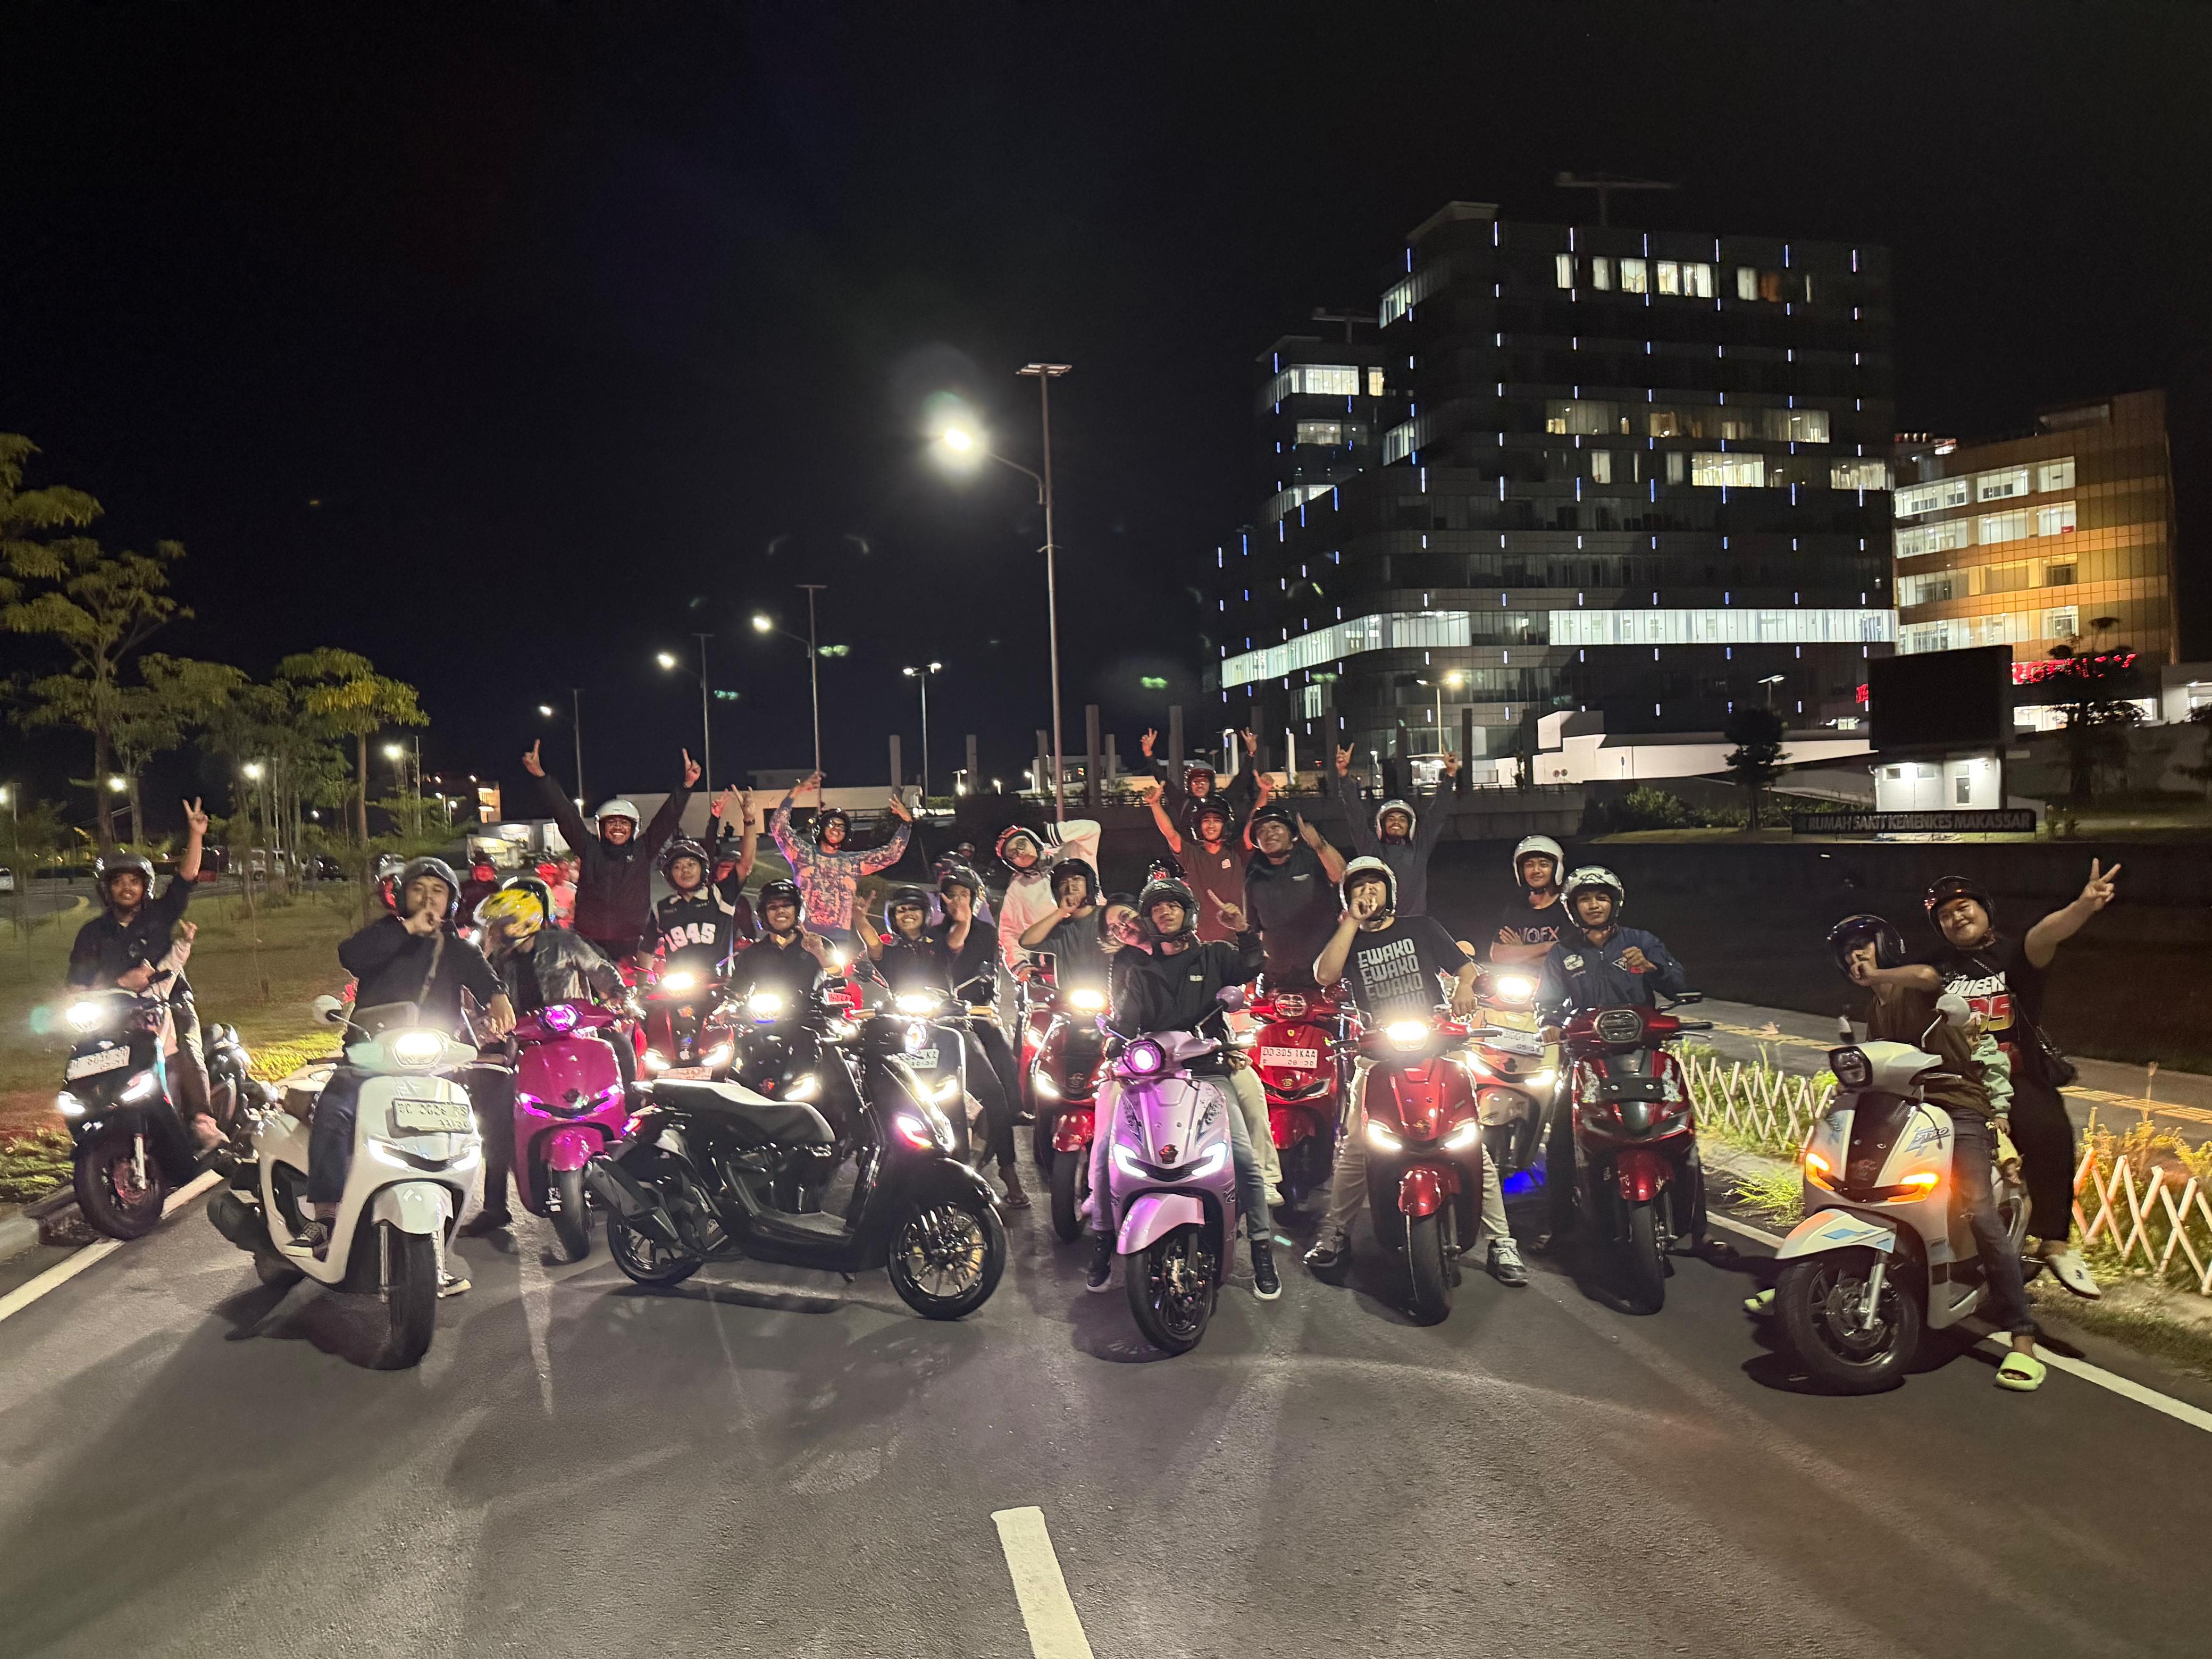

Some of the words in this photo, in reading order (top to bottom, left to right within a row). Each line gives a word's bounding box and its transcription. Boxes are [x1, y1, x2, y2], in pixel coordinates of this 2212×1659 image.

[1809, 815, 1851, 831] RUMAH
[1854, 814, 1887, 830] SAKIT
[1954, 812, 2030, 830] MAKASSAR
[665, 923, 716, 952] 1945
[1357, 938, 1415, 968] EWAKO
[1360, 954, 1420, 985] EWAKO
[1945, 971, 2006, 996] QUEEN
[1365, 973, 1424, 1002] EWAKO
